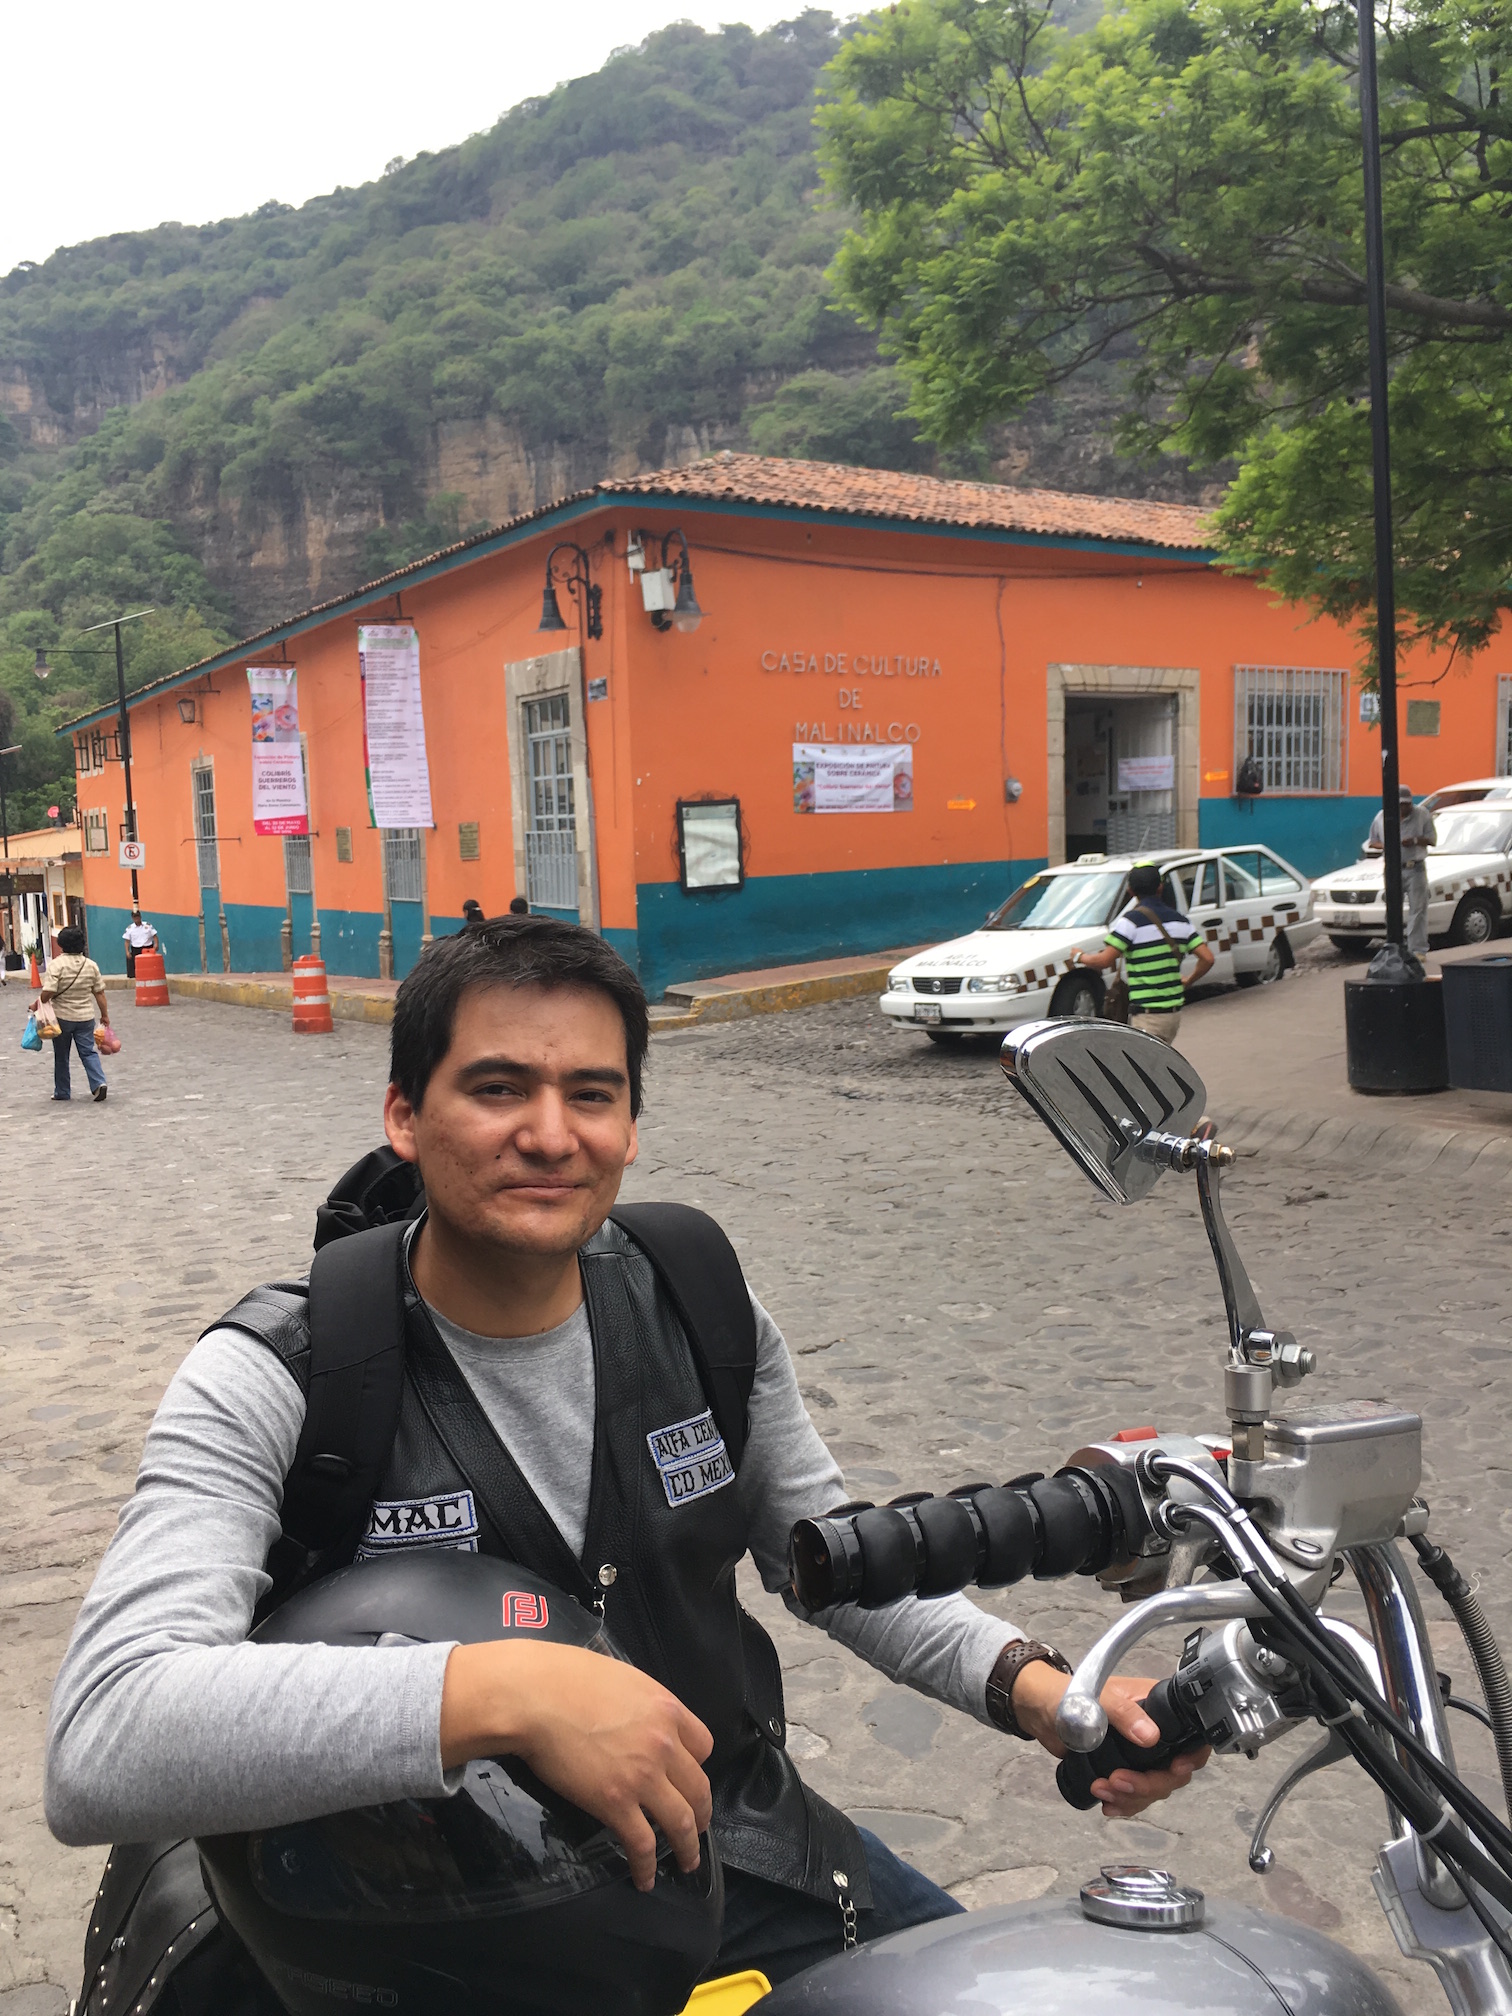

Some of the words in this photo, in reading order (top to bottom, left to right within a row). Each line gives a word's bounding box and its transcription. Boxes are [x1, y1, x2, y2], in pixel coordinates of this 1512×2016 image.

[761, 650, 819, 674] CASA
[824, 652, 849, 674] DE
[853, 654, 942, 677] CULTURA
[838, 687, 864, 709] DE
[795, 721, 922, 744] MALINALCO
[915, 959, 988, 967] MALINALCO
[668, 1469, 695, 1498] CD
[368, 1499, 463, 1536] MAC
